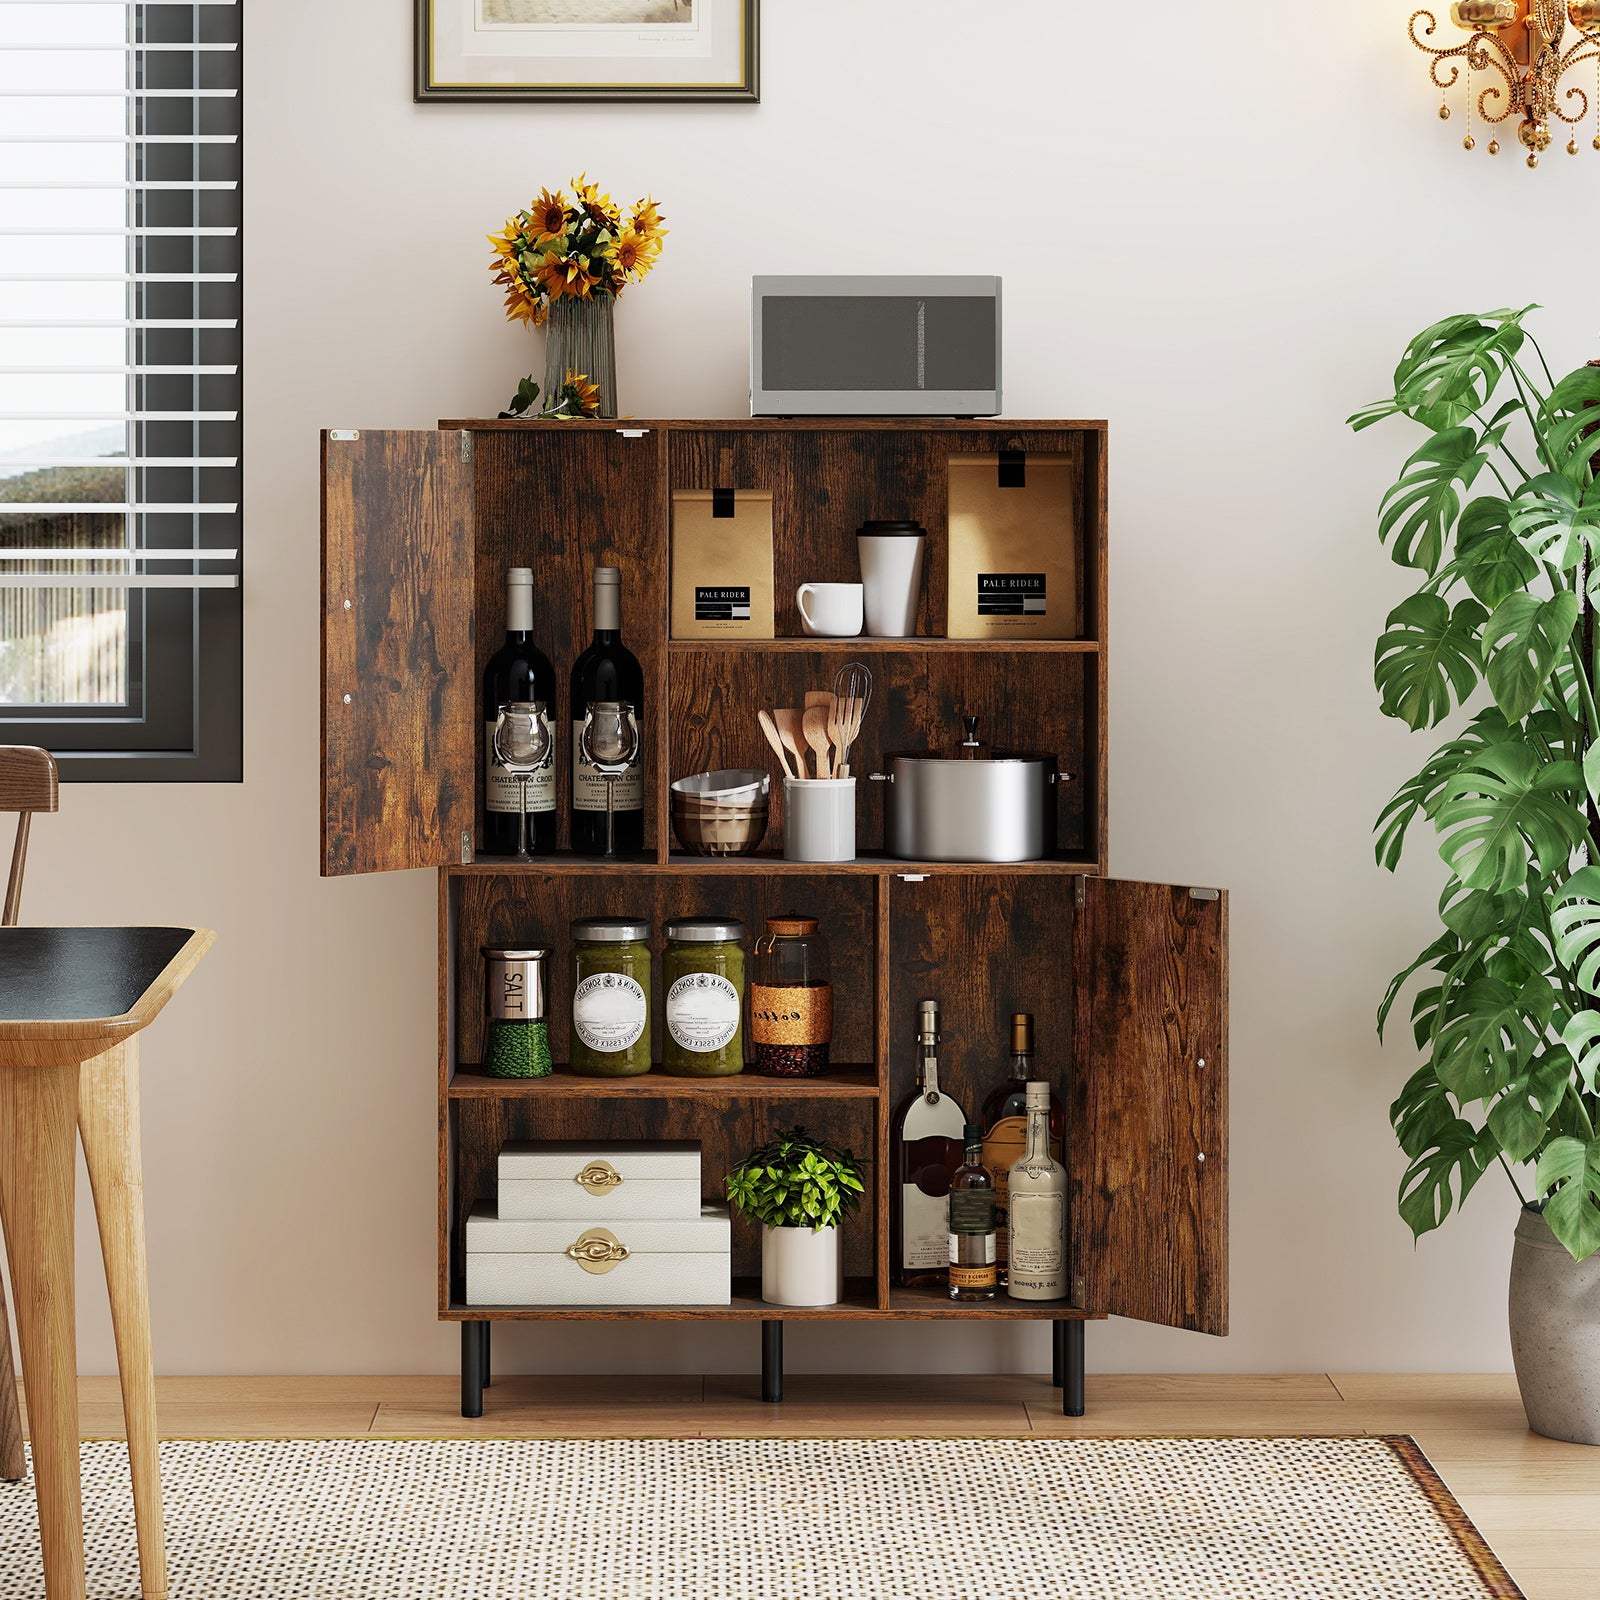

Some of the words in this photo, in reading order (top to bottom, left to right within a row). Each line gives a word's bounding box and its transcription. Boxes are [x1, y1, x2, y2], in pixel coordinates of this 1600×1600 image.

[983, 579, 1007, 588] PALE
[1009, 579, 1040, 588] RIDER
[699, 591, 719, 599] PALE
[720, 591, 745, 599] RIDER
[504, 972, 523, 1012] SALT
